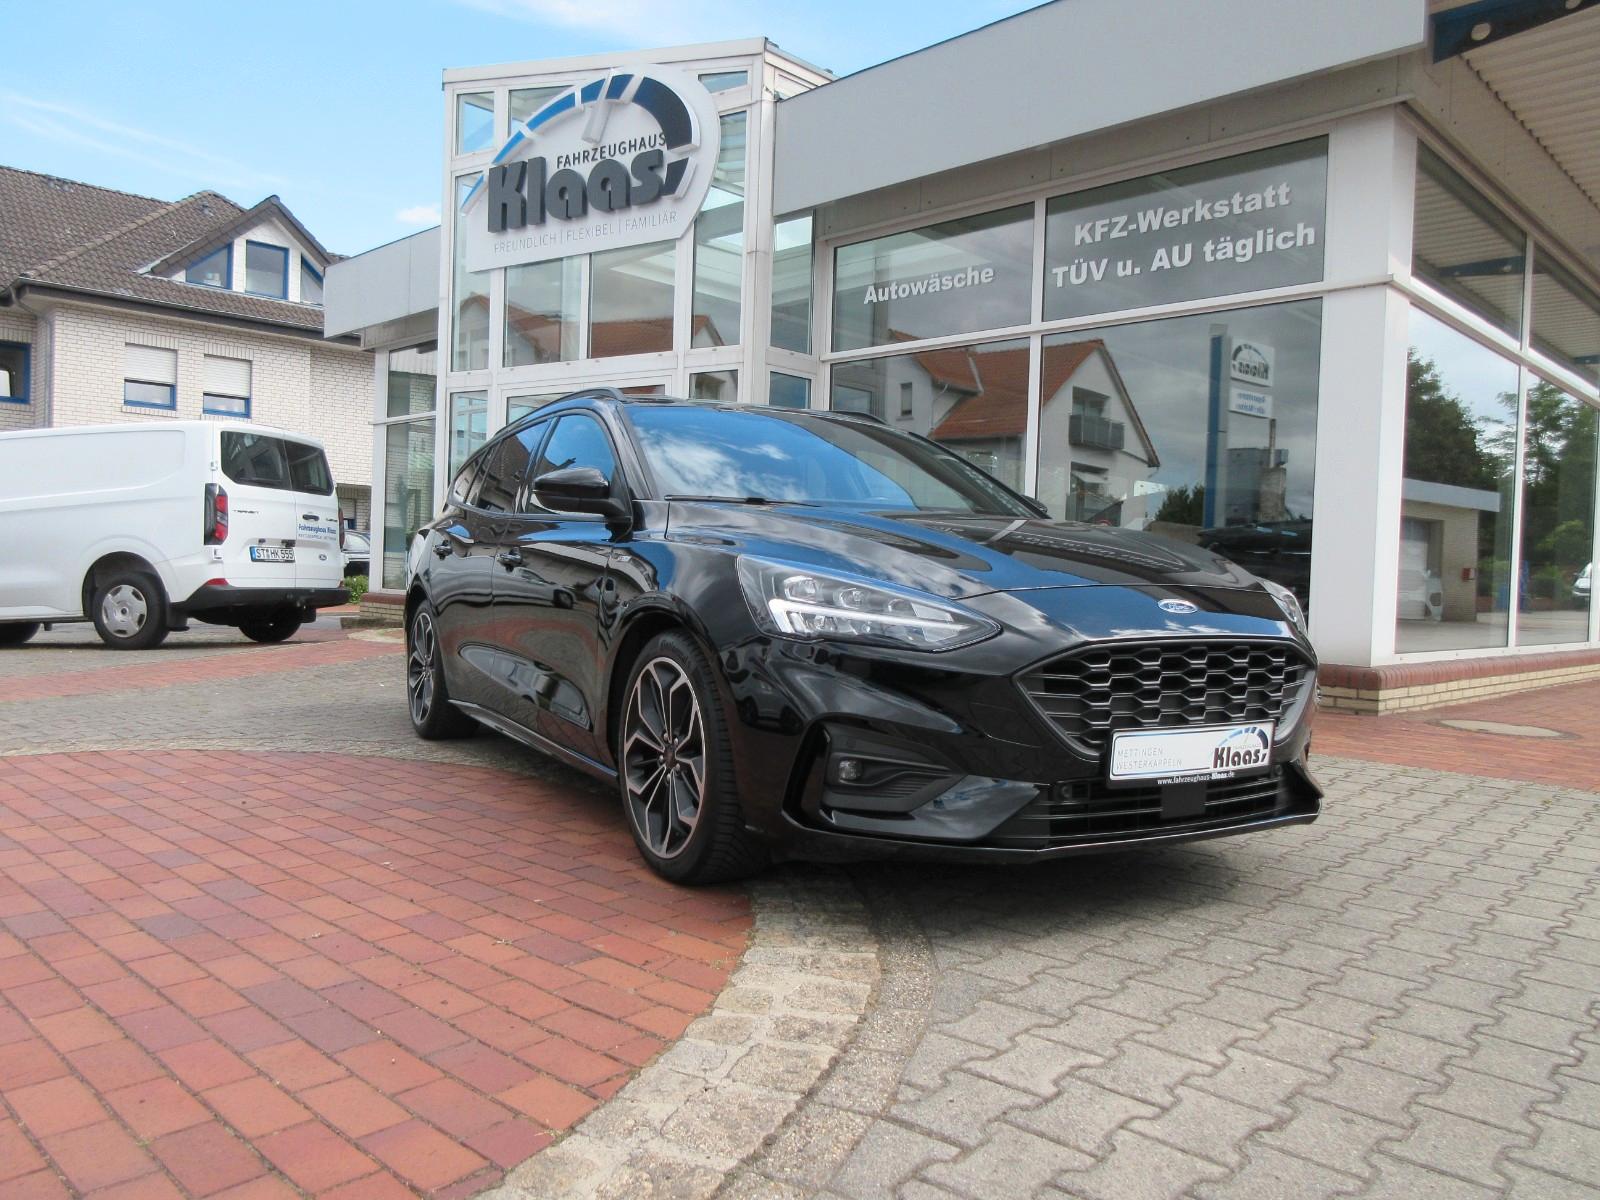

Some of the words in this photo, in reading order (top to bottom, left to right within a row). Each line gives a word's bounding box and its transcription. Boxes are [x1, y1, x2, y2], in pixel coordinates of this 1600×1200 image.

[556, 132, 666, 168] FAHRZEUGHAUS
[487, 149, 664, 233] Klaas
[494, 233, 557, 253] FREUNDLICH
[566, 223, 614, 241] FLEXIBEL
[626, 209, 677, 232] FAMILIÄR
[1074, 181, 1291, 246] KFZ-Werkstatt
[1052, 259, 1107, 289] TÜV
[1116, 259, 1141, 276] u.
[1150, 243, 1192, 272] AU
[1203, 222, 1316, 266] täglich
[864, 265, 995, 305] Autowäsche
[280, 550, 295, 561] 555
[1117, 747, 1163, 758] METTINGEN
[1213, 746, 1261, 769] Klaas
